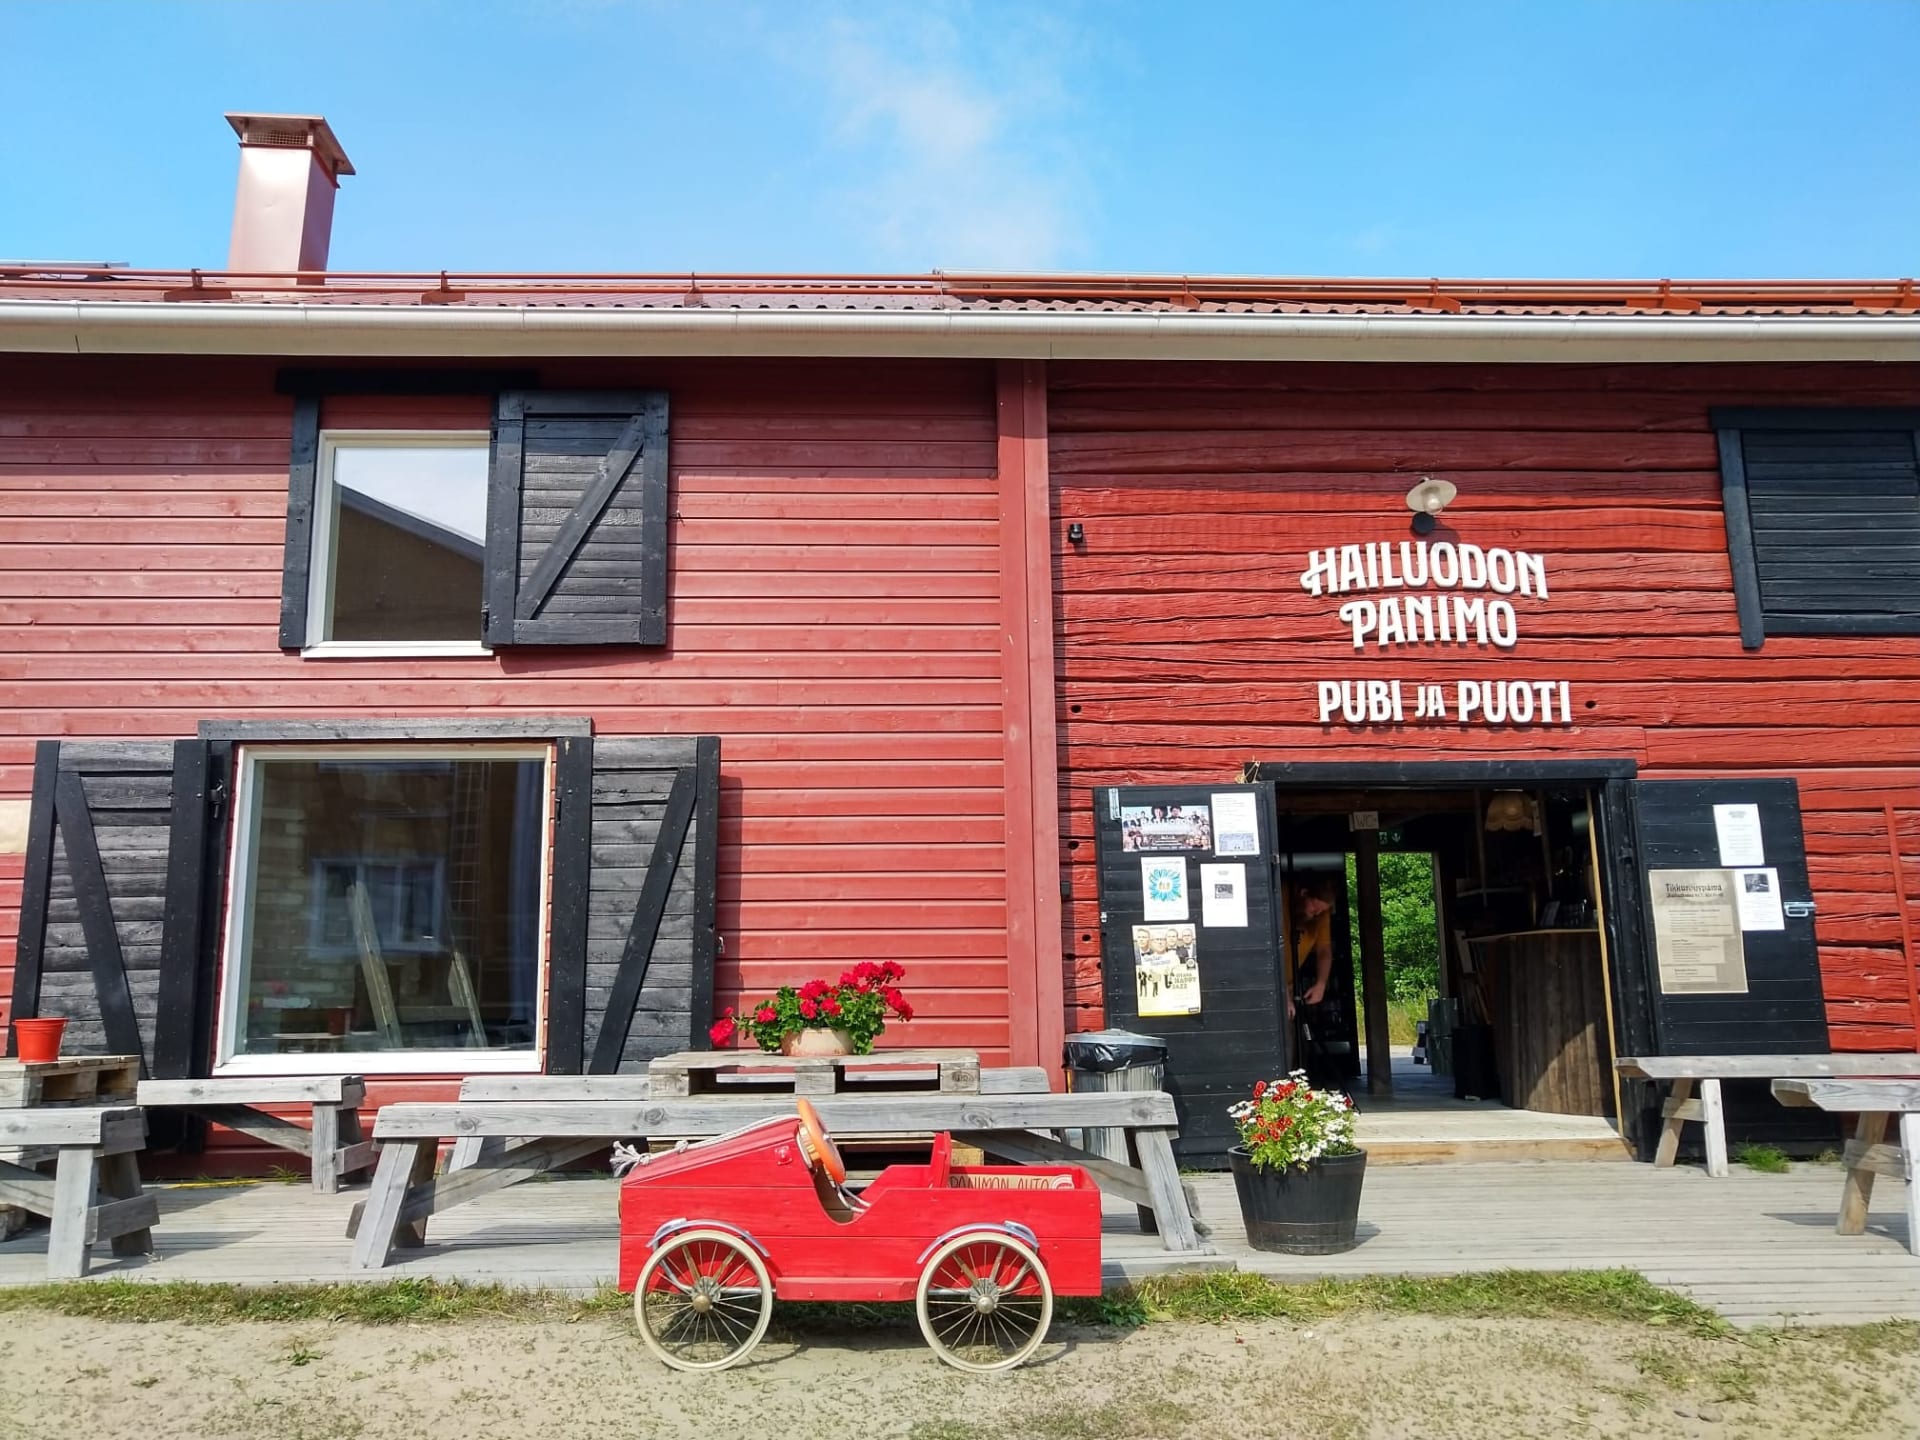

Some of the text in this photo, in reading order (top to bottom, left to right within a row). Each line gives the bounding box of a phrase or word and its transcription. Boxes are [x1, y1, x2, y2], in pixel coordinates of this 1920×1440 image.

[1300, 541, 1549, 600] HAILUODON
[1339, 595, 1517, 648] PANIMO
[1318, 680, 1572, 723] PUBI JA PUOTI
[1017, 1177, 1050, 1190] AUTO
